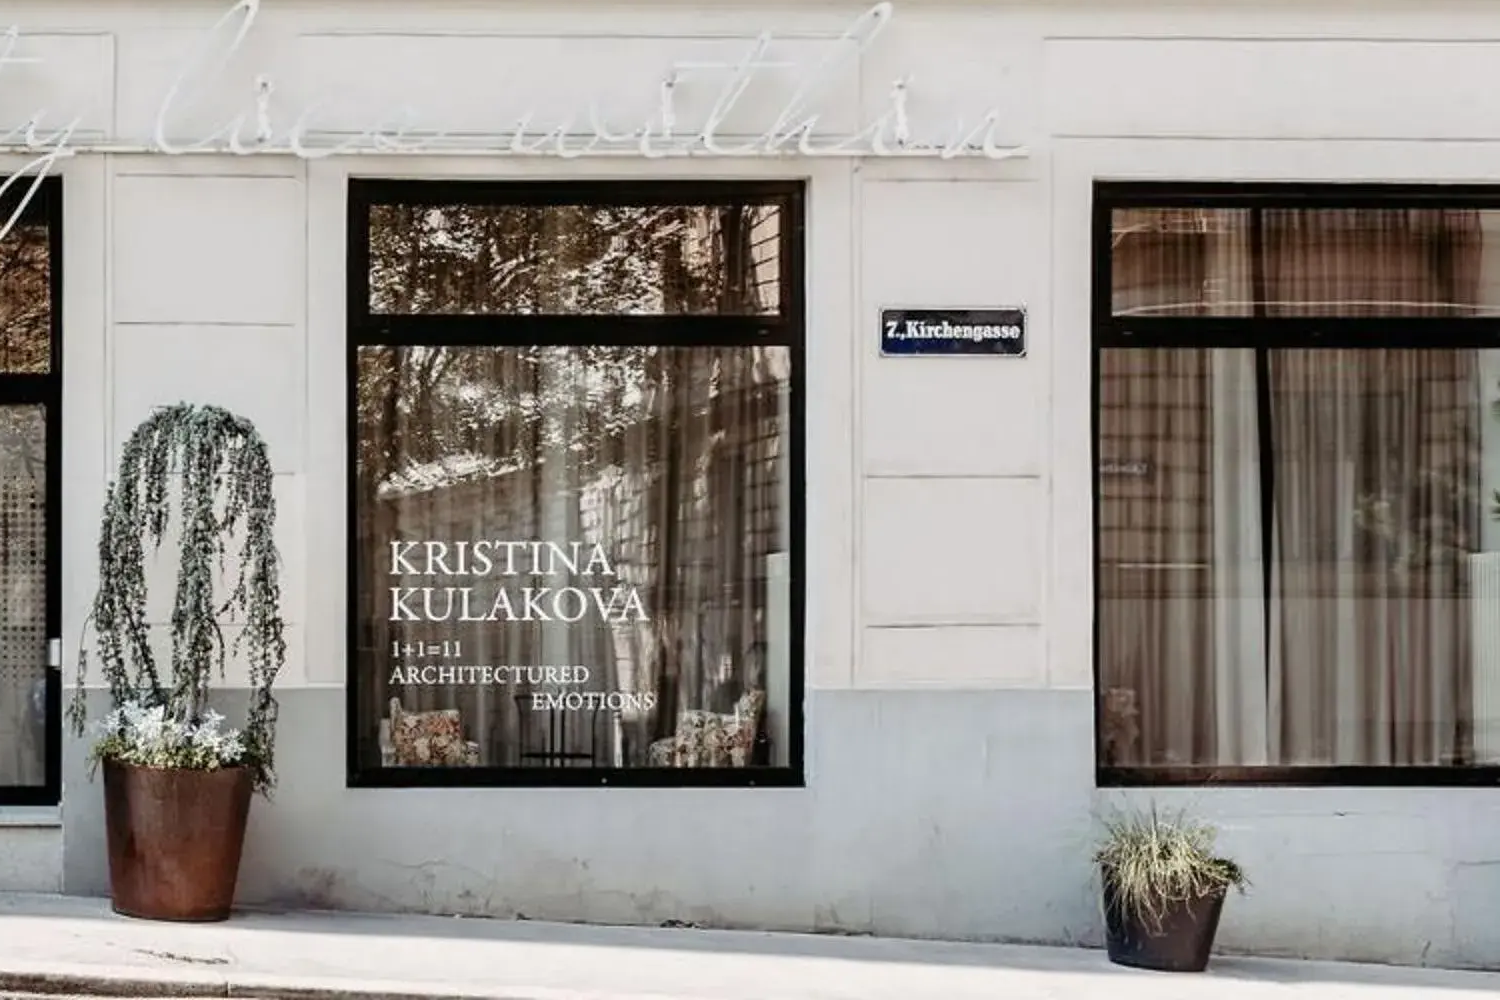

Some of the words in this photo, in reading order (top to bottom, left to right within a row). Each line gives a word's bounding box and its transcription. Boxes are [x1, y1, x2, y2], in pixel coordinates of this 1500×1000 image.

[389, 540, 616, 577] KRISTINA
[389, 586, 651, 623] KULAKOVA
[392, 640, 462, 658] 1+1=11
[389, 666, 589, 685] ARCHITECTURED
[531, 692, 656, 712] EMOTIONS
